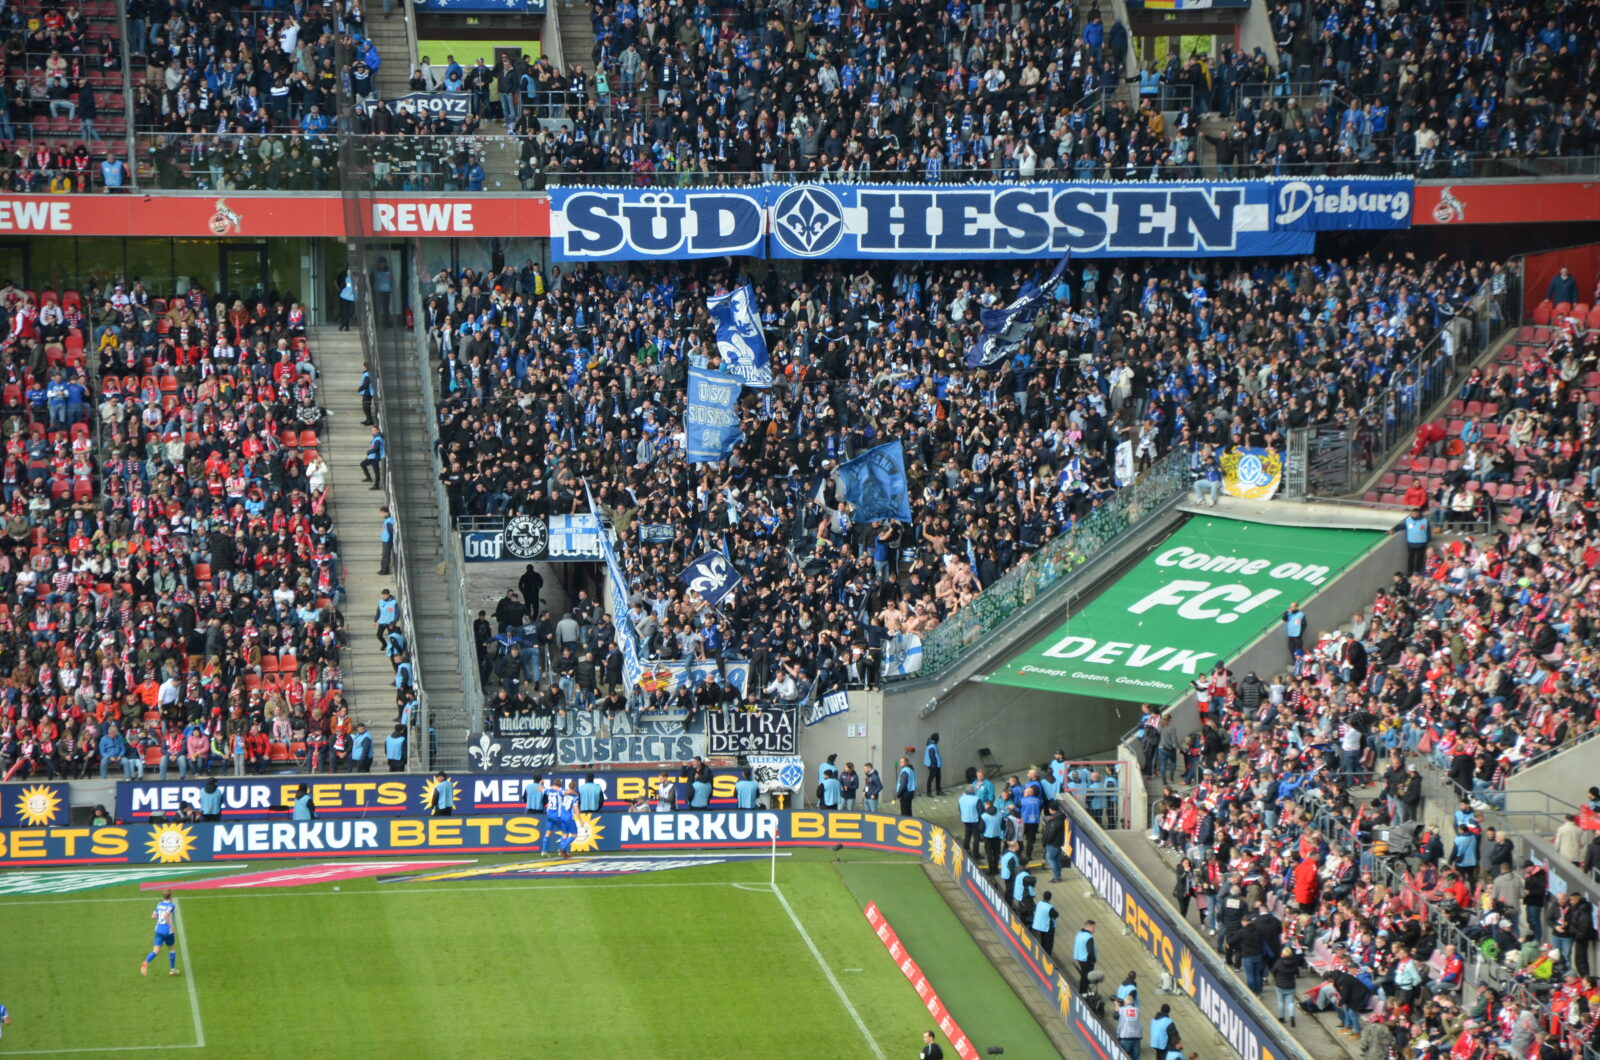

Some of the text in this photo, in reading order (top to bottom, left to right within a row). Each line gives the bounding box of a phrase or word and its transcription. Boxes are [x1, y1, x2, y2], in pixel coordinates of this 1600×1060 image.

[417, 98, 467, 113] BOYZ
[372, 203, 474, 232] REWE
[1275, 182, 1411, 225] Dieburg
[563, 187, 1247, 256] SÜD HESSEN
[1155, 546, 1272, 576] Come
[1127, 579, 1283, 624] FC!
[1041, 635, 1218, 676] DEVK
[498, 709, 552, 736] underdogs
[710, 711, 793, 734] ULTRA
[511, 736, 552, 751] ROW
[559, 735, 695, 764] SUSPECTS
[764, 733, 793, 751] LIS
[500, 753, 555, 768] SEVEN
[0, 827, 129, 858] ETS
[213, 815, 540, 852] MERKUR BETS
[620, 811, 923, 847] MERKUR BETS
